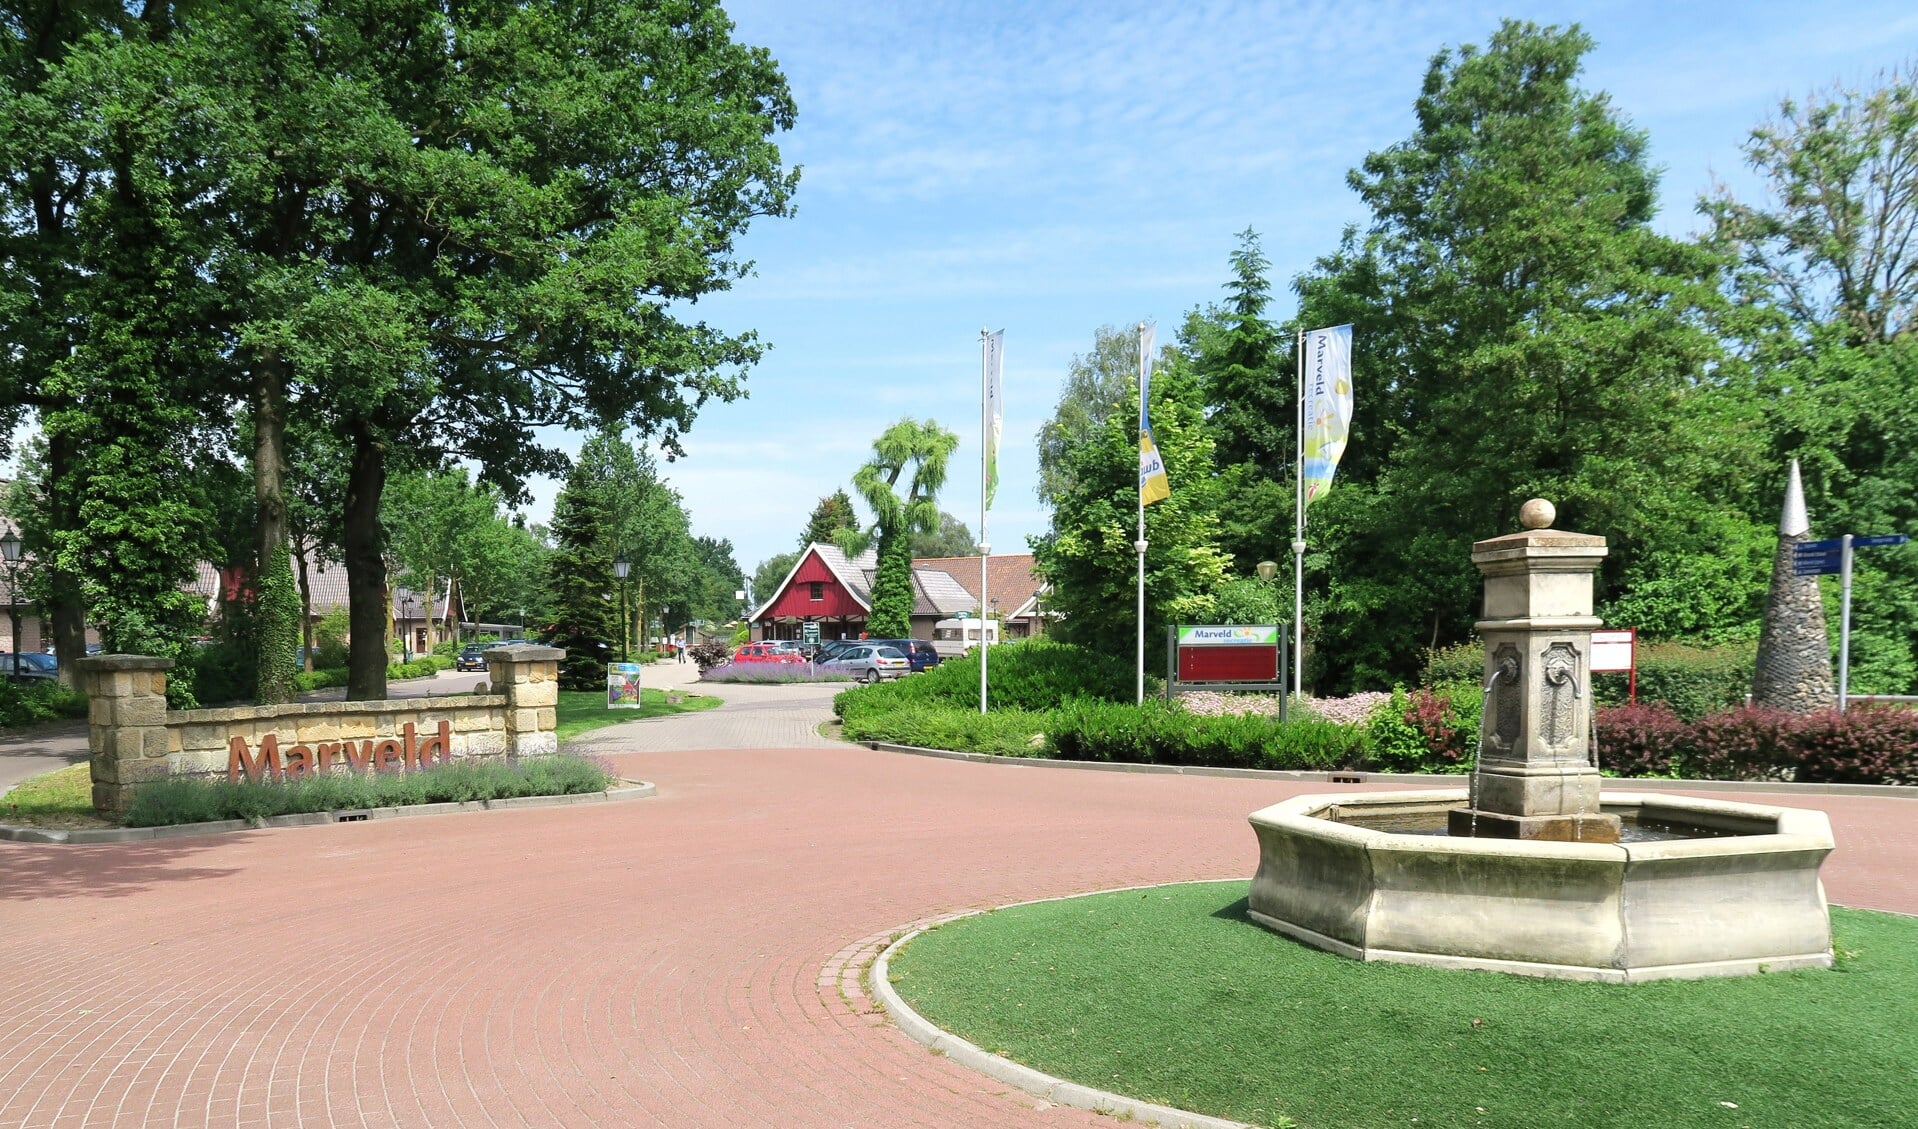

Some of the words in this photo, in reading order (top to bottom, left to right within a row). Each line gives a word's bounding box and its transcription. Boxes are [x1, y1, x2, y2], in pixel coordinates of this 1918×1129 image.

[1315, 335, 1327, 396] Marveld
[1195, 630, 1232, 638] Marveld
[228, 719, 451, 784] Marveld
